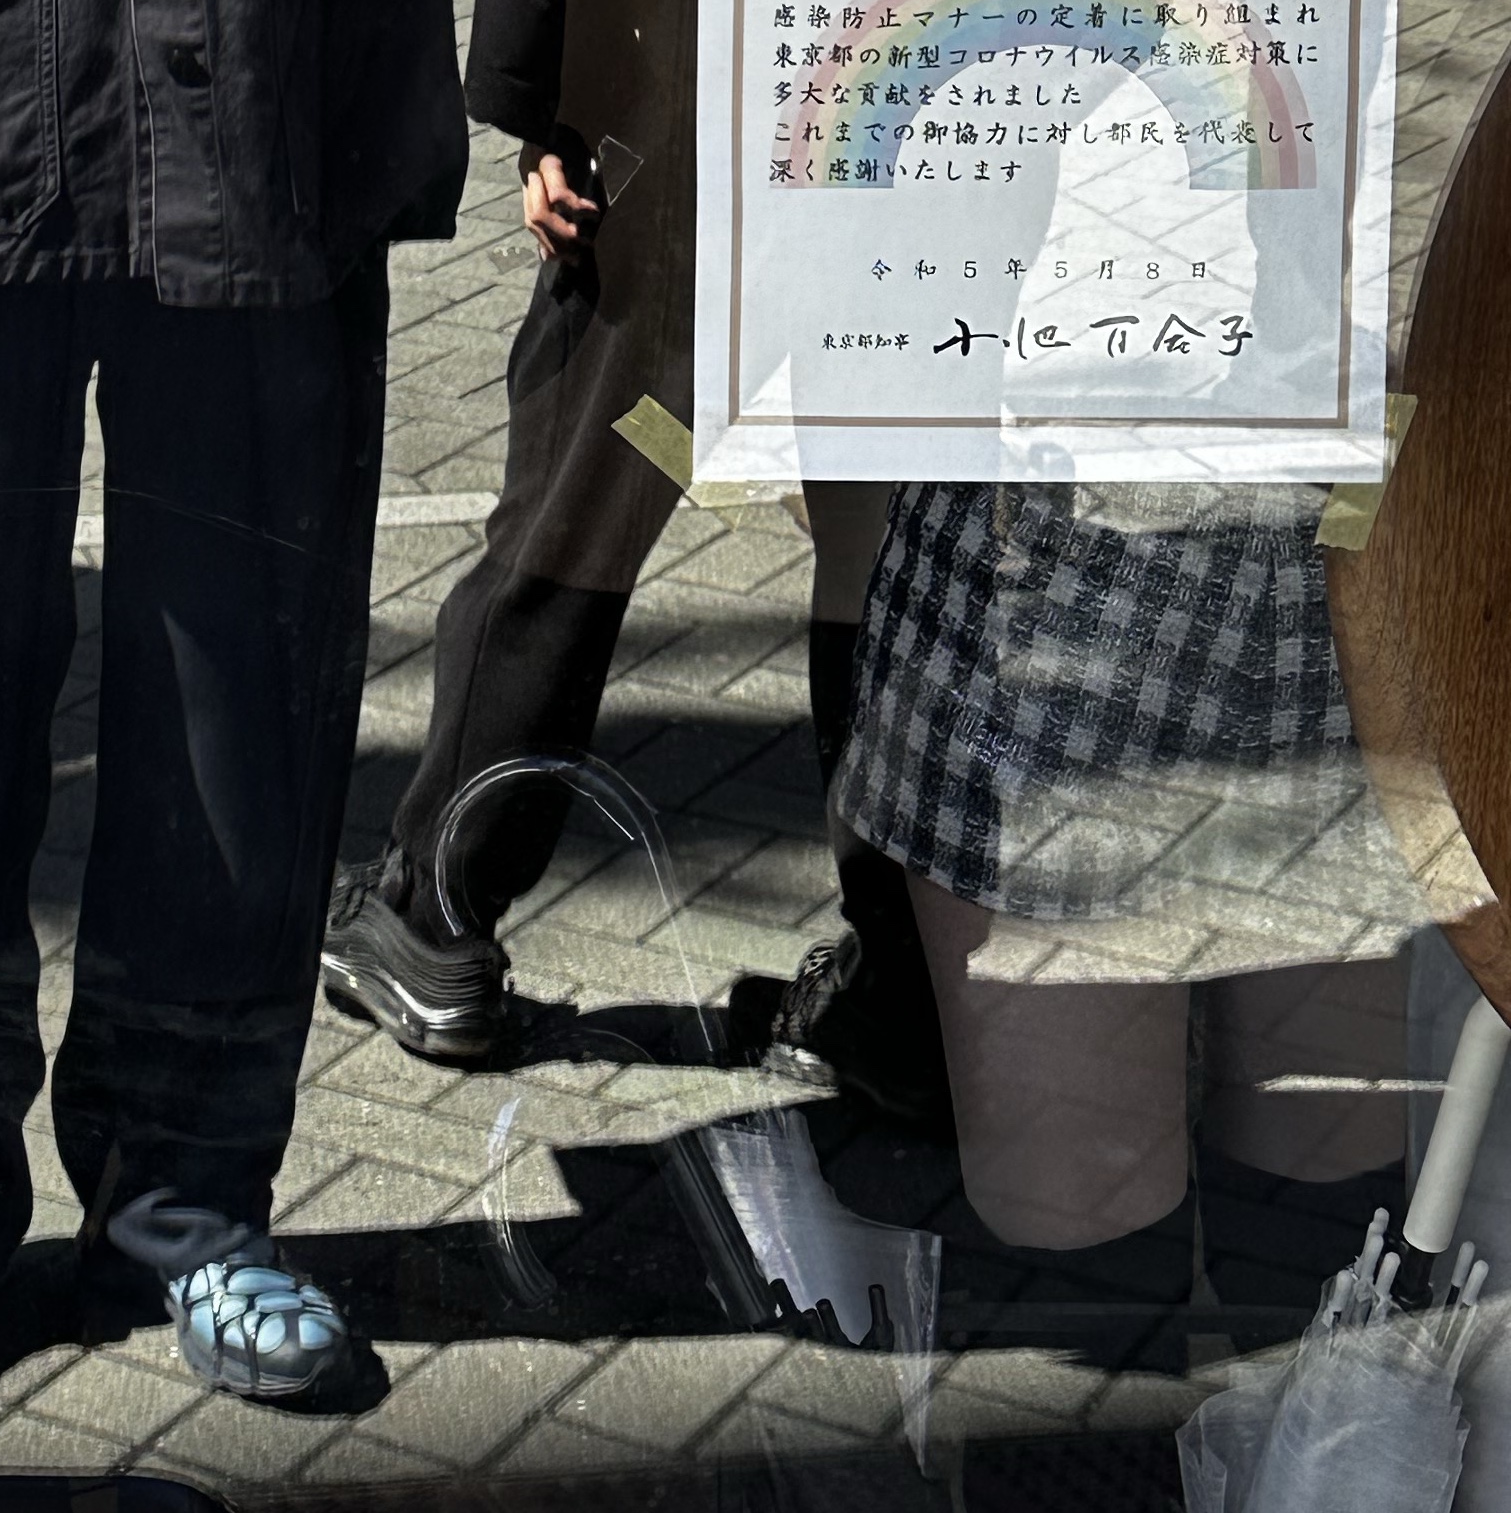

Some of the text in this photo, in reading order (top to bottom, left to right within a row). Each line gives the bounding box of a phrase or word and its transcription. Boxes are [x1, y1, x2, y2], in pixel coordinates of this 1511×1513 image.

[773, 82, 1082, 106] 多大な貢献をされました
[769, 157, 1023, 183] 深く感謝いたします
